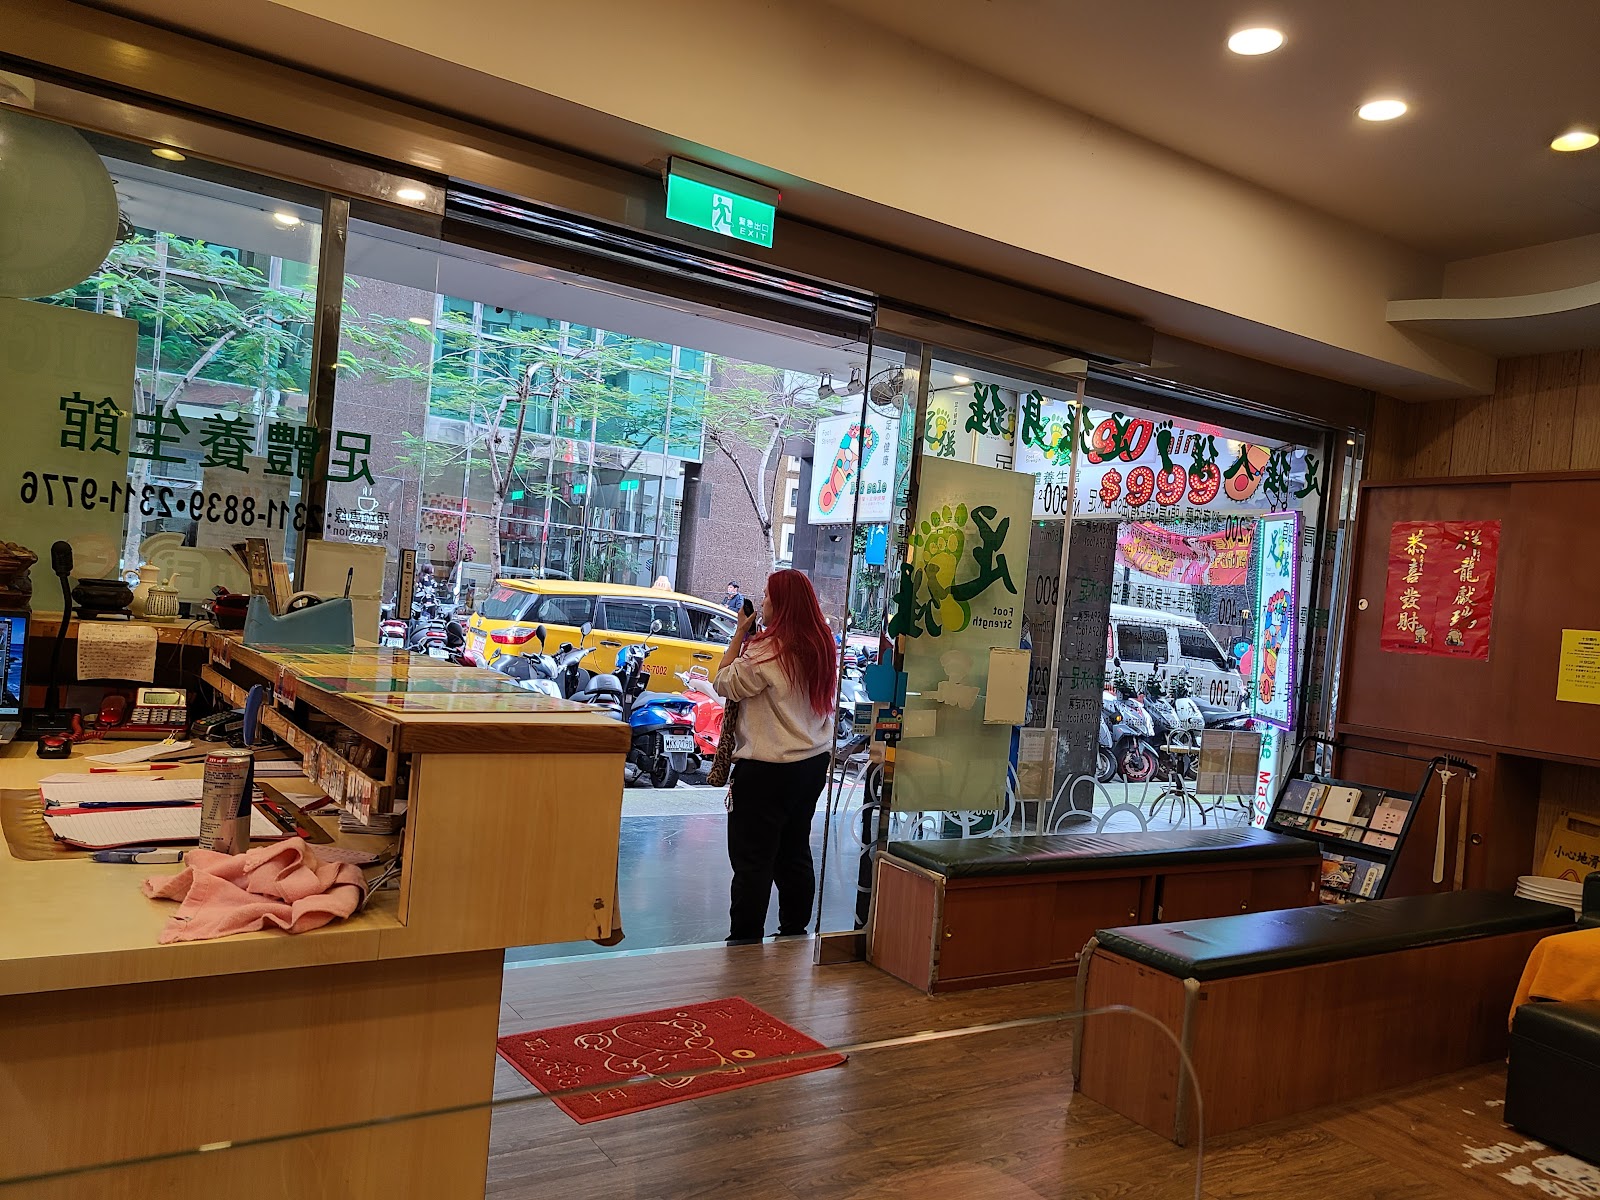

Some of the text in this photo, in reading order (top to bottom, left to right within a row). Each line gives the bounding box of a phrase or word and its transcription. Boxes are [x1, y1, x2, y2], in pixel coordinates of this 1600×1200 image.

[738, 216, 769, 233] 緊急出口
[740, 227, 767, 240] EXIT
[1098, 463, 1221, 506] $999
[348, 533, 379, 544] Coffee
[1396, 529, 1428, 633] 恭喜發財
